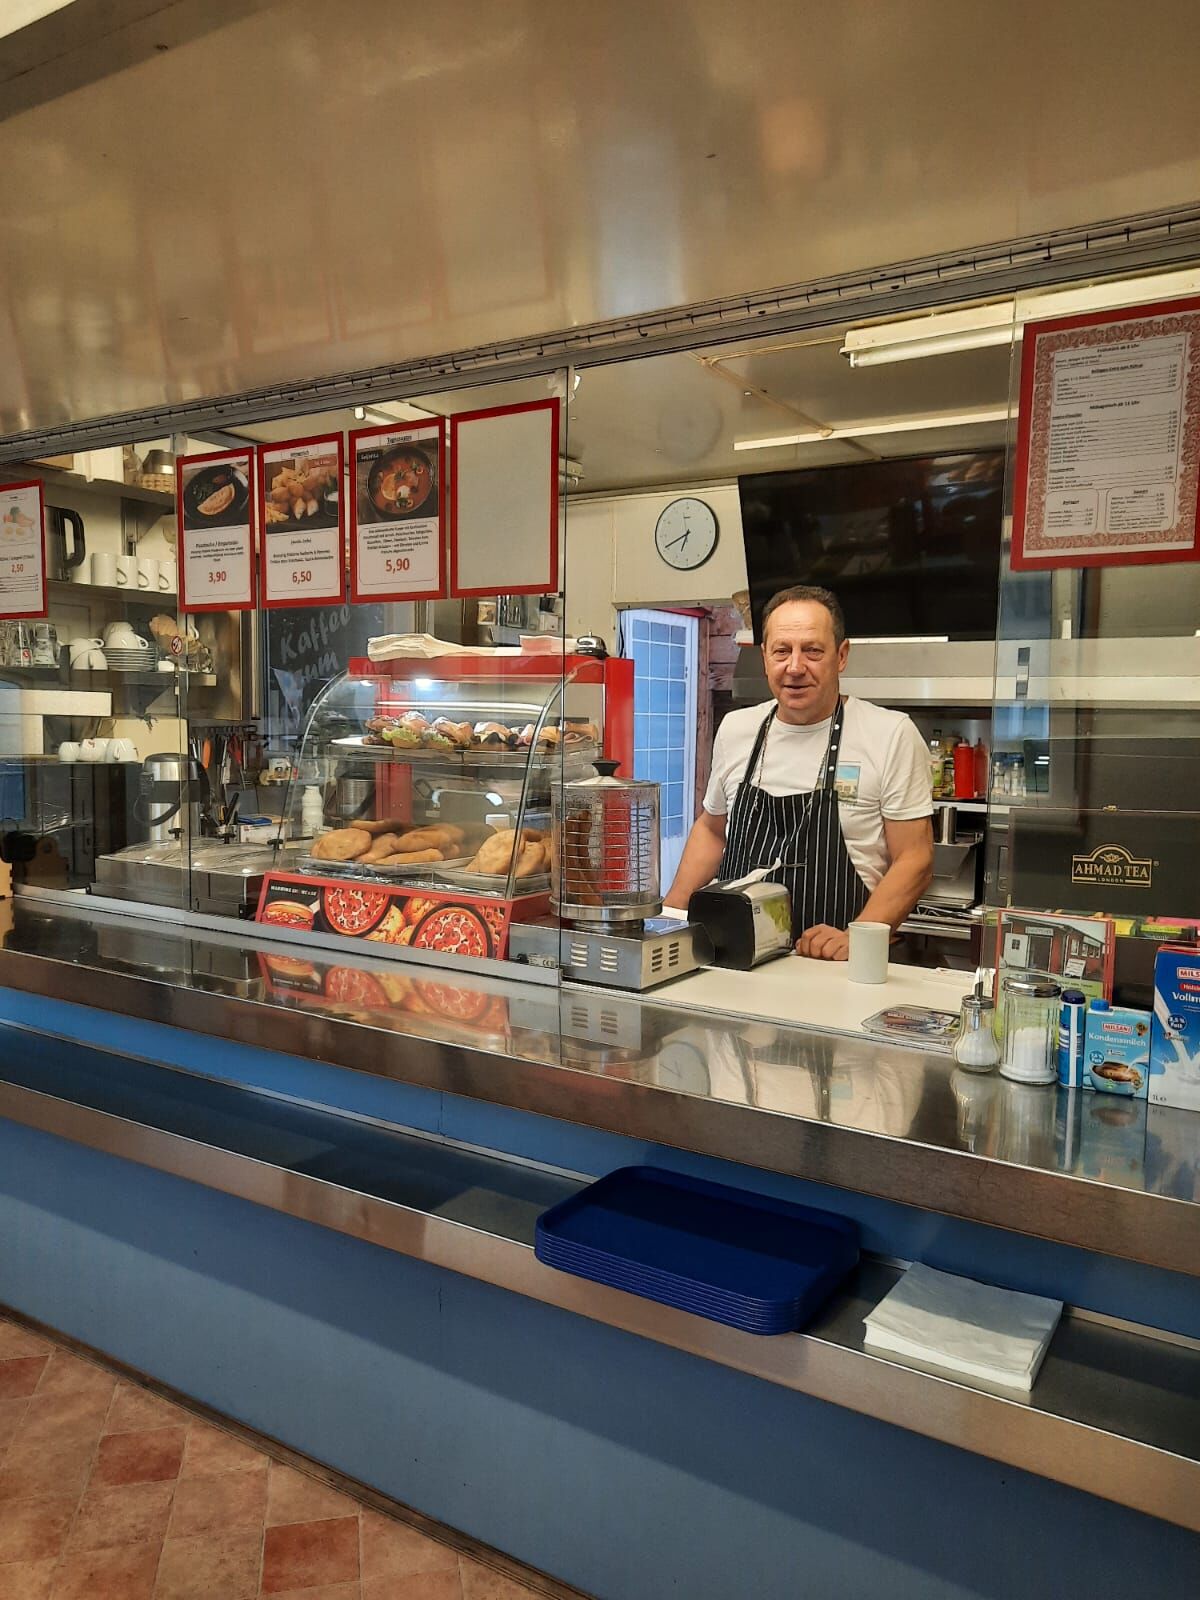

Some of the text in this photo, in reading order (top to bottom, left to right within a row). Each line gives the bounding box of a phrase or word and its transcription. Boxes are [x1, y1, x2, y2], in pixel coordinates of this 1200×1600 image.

[11, 563, 24, 574] 2,50
[386, 558, 410, 574] 5,90
[208, 571, 227, 584] 3,90
[292, 570, 312, 584] 6,50
[280, 605, 351, 664] Kaffee
[1075, 863, 1148, 878] AHMAD TEA
[1088, 1032, 1146, 1046] Kondensmilch
